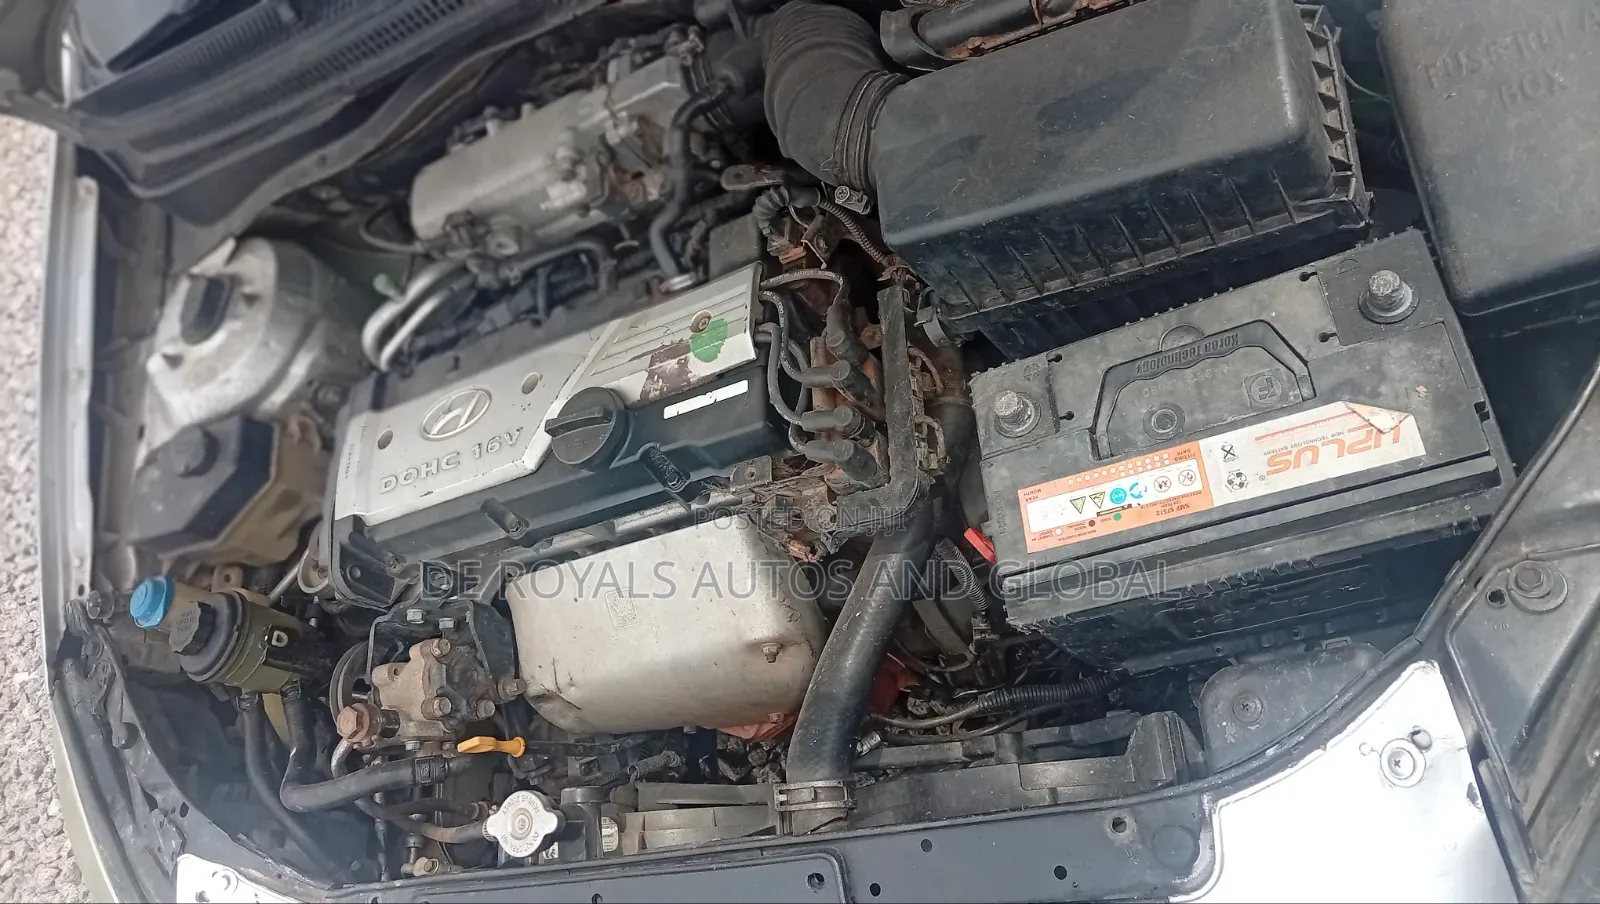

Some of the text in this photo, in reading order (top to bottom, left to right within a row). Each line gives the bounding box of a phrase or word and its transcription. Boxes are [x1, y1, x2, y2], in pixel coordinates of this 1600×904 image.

[1136, 333, 1240, 374] Korea Technology
[1176, 447, 1192, 455] DATE
[1263, 431, 1345, 456] NEW TECHNOLOGY BATTERY
[1266, 424, 1401, 476] UPLUS
[379, 451, 461, 495] DOHC
[471, 426, 524, 459] 16V
[1174, 453, 1196, 462] FITTING
[1023, 488, 1042, 496] MONTH
